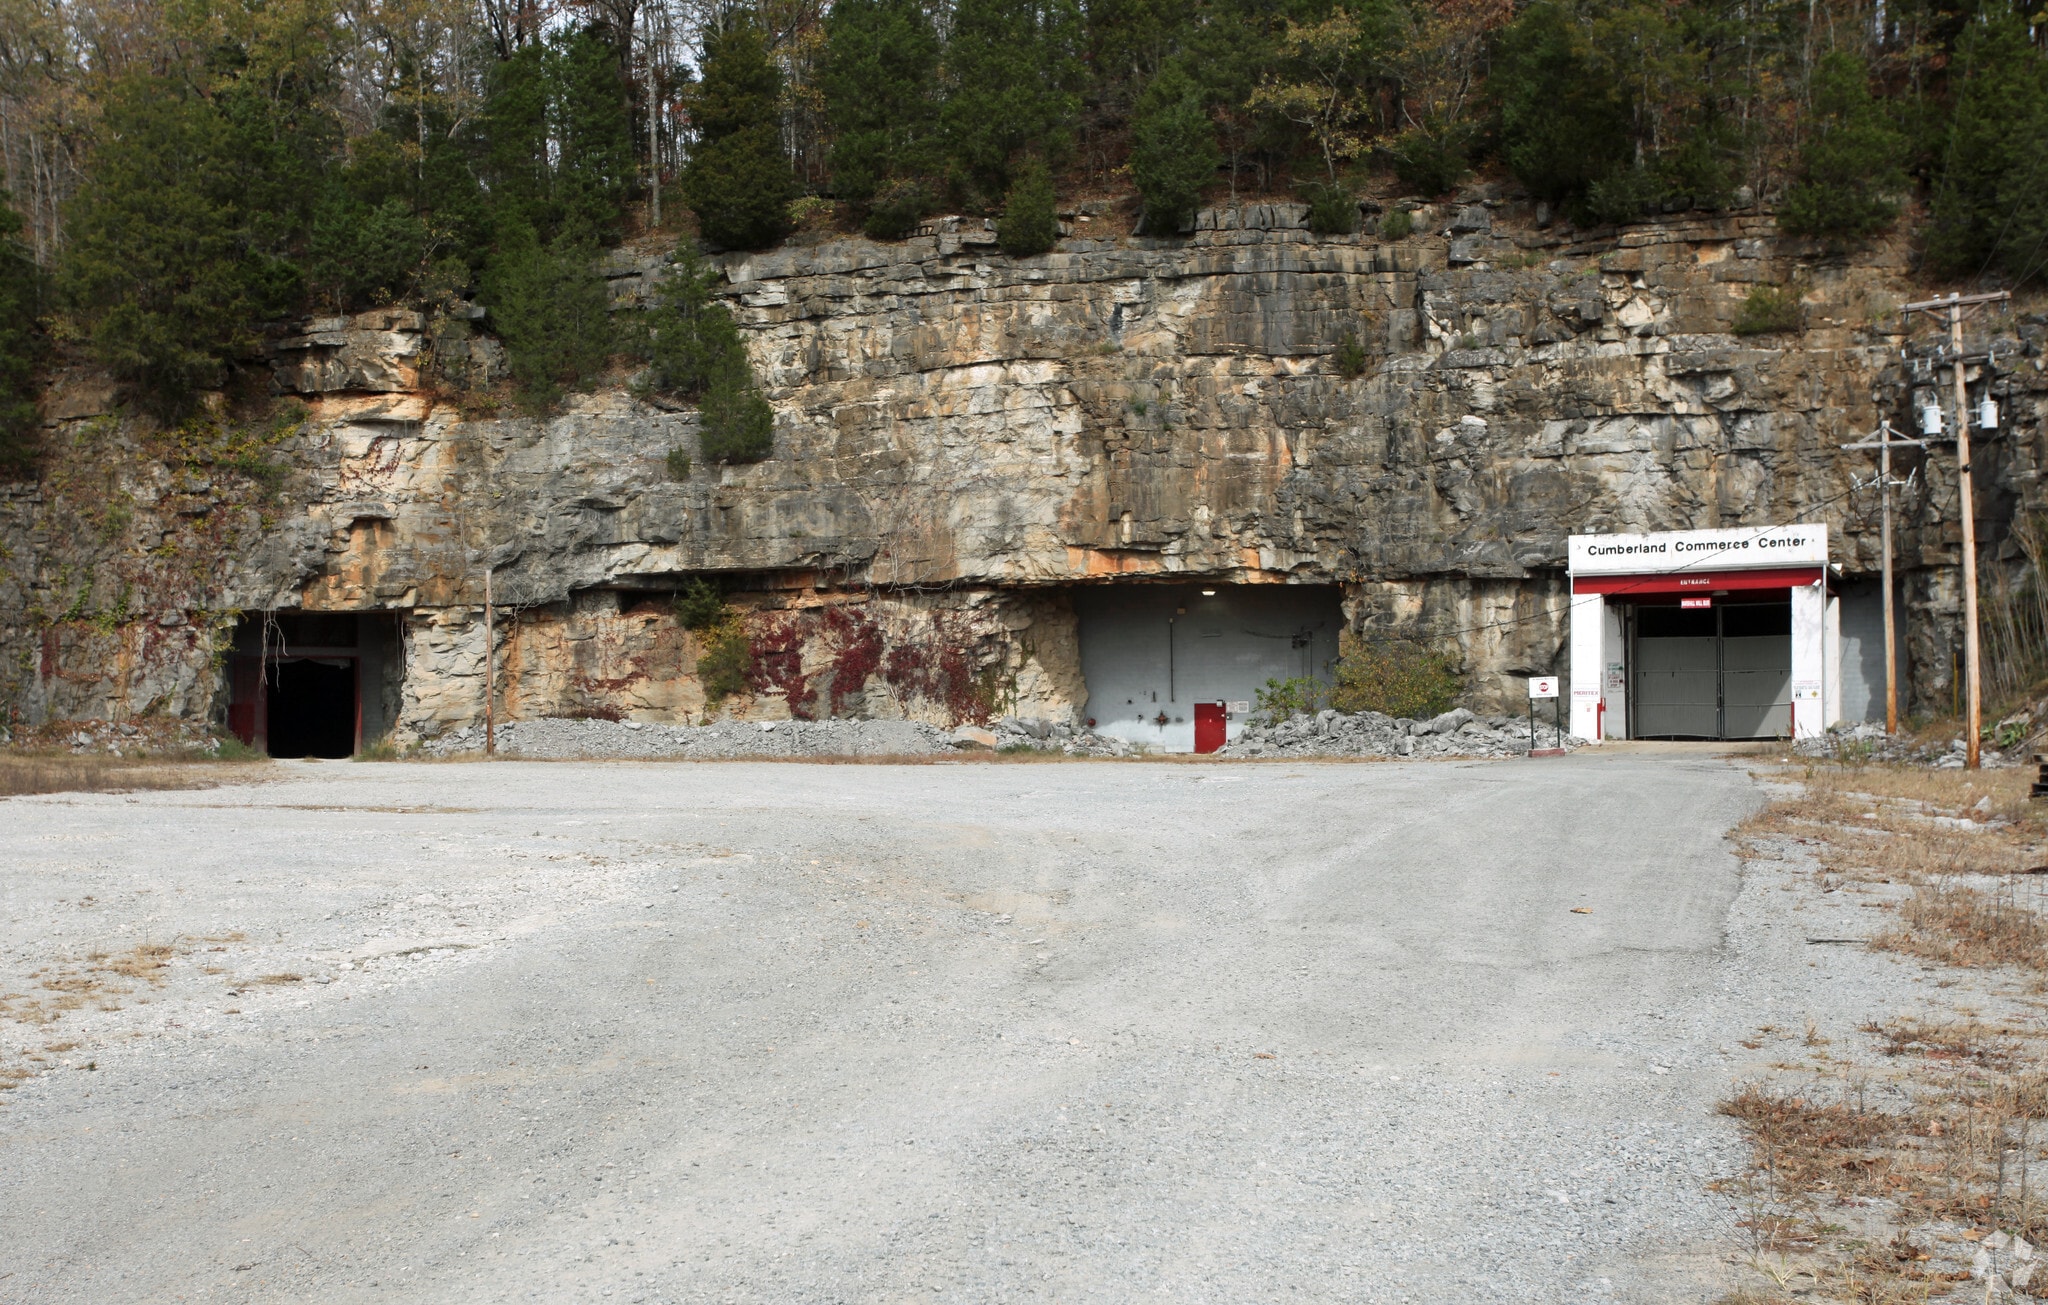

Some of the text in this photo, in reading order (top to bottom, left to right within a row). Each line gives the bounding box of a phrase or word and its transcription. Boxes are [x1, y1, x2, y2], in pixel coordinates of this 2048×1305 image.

[1587, 537, 1807, 556] Cumberland Commerce Center
[1680, 578, 1710, 586] ENTRANCE
